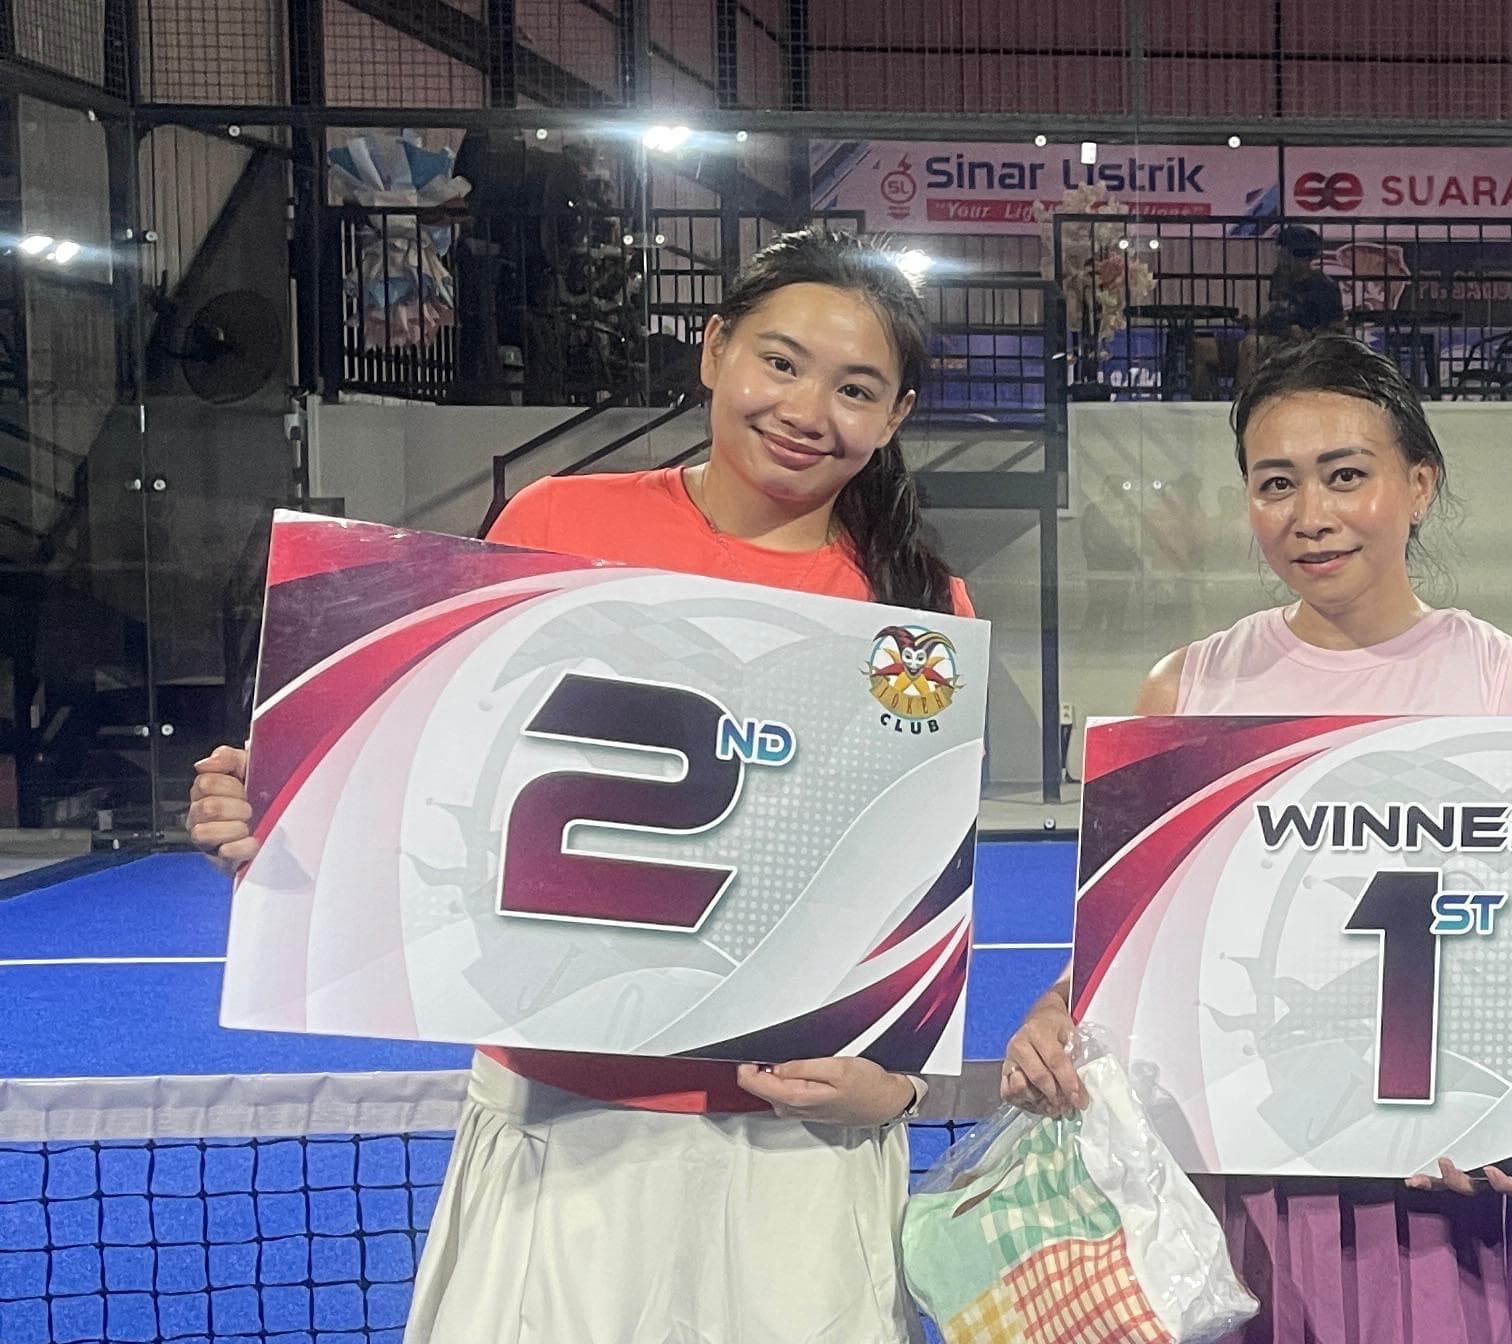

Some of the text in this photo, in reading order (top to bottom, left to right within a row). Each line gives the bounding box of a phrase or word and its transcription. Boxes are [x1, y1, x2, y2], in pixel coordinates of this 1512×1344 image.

[925, 153, 1205, 193] Sinar Listrik
[879, 686, 945, 715] JOKER
[880, 713, 940, 735] CLUB
